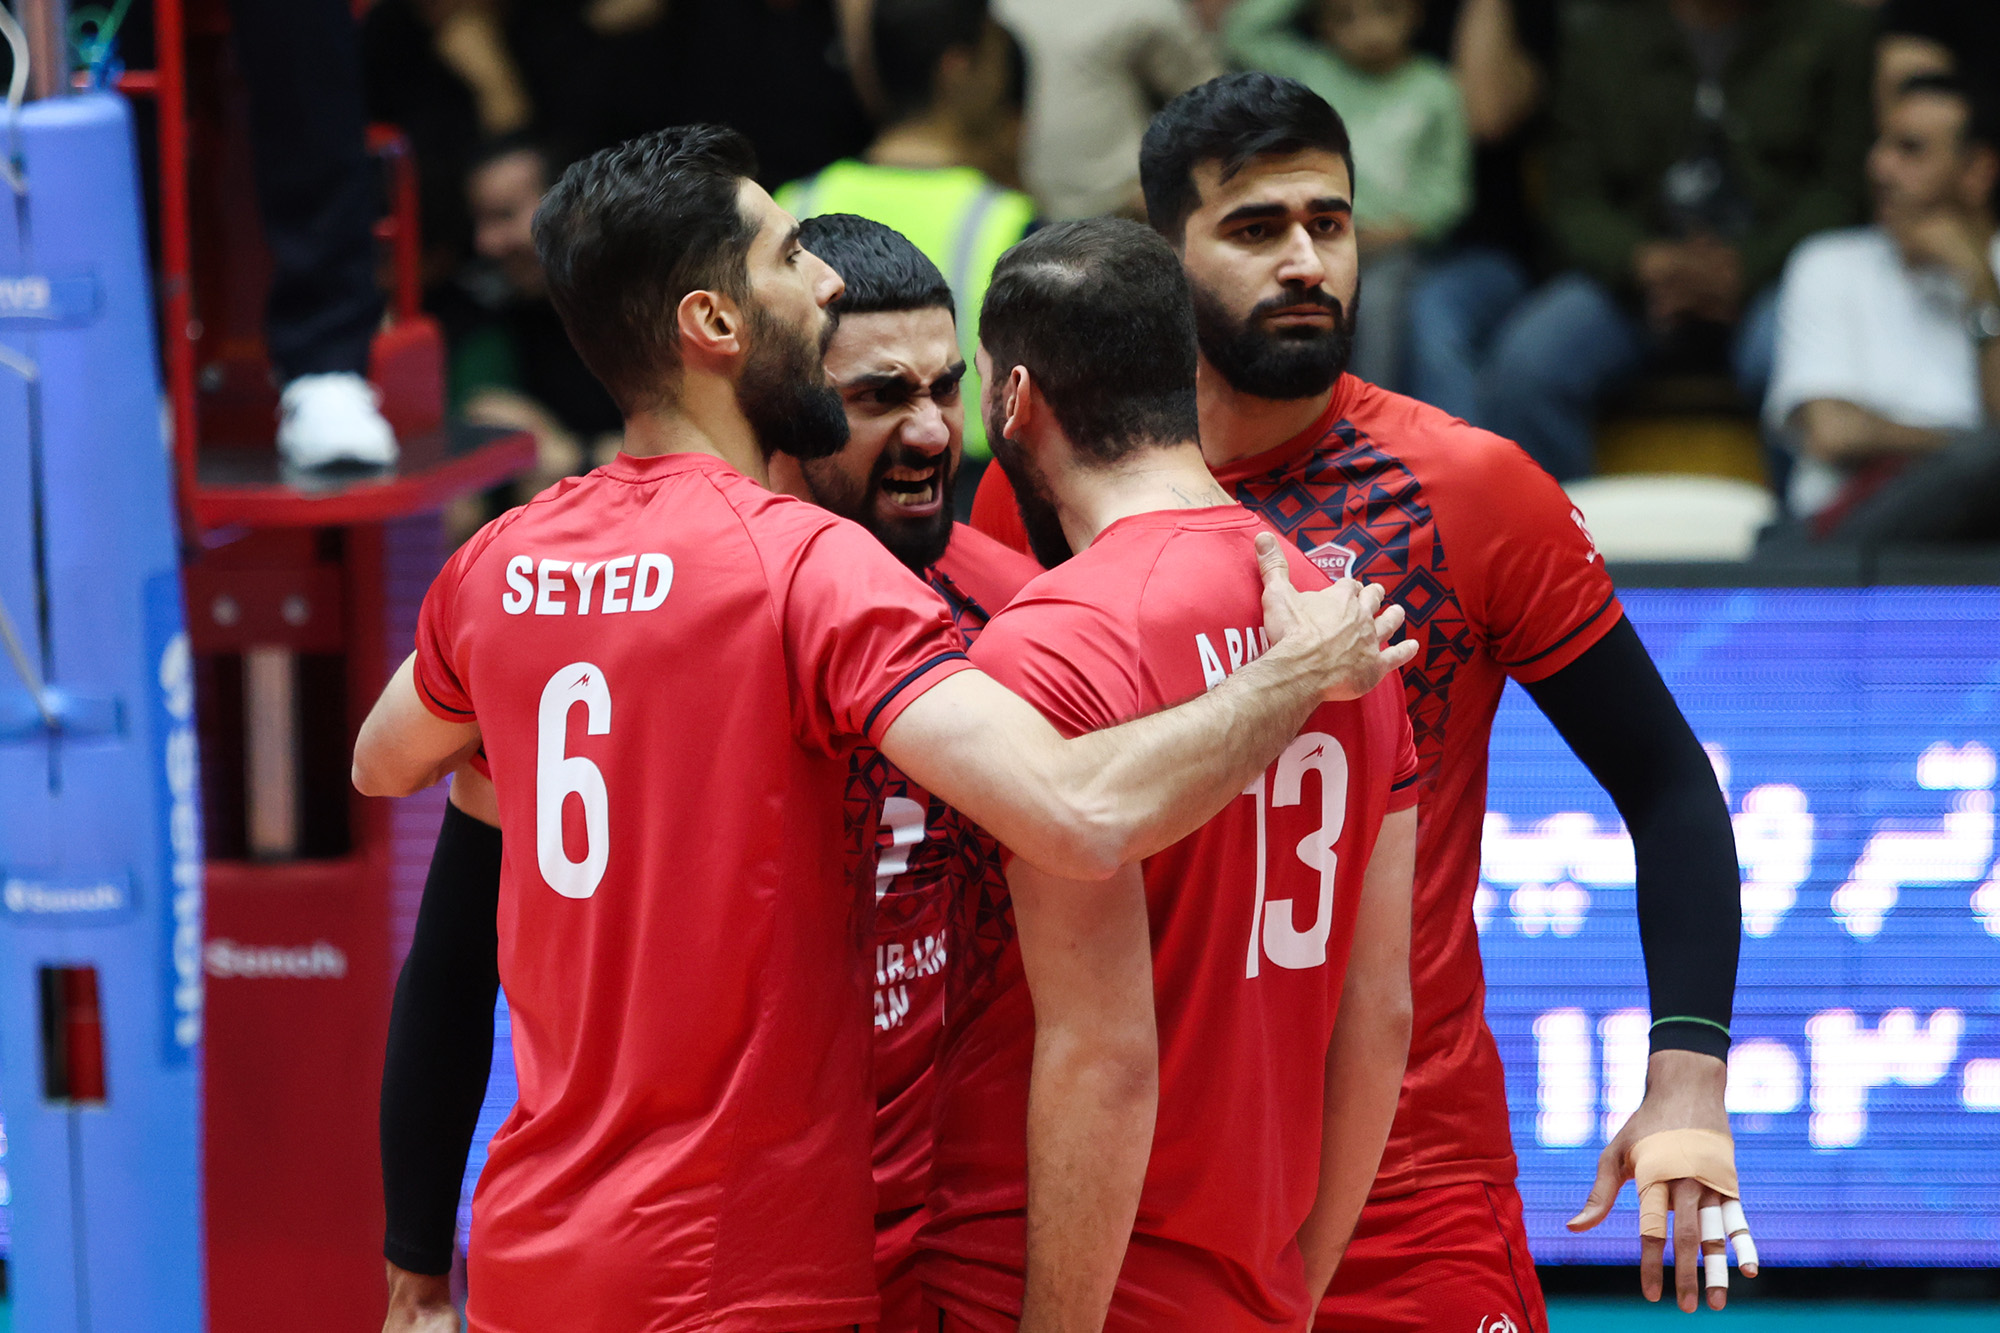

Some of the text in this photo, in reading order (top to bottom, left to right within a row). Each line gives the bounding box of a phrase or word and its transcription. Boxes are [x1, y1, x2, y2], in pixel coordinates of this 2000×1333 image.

[502, 553, 674, 616] SEYED
[536, 661, 612, 899] 6
[1242, 731, 1349, 980] 13
